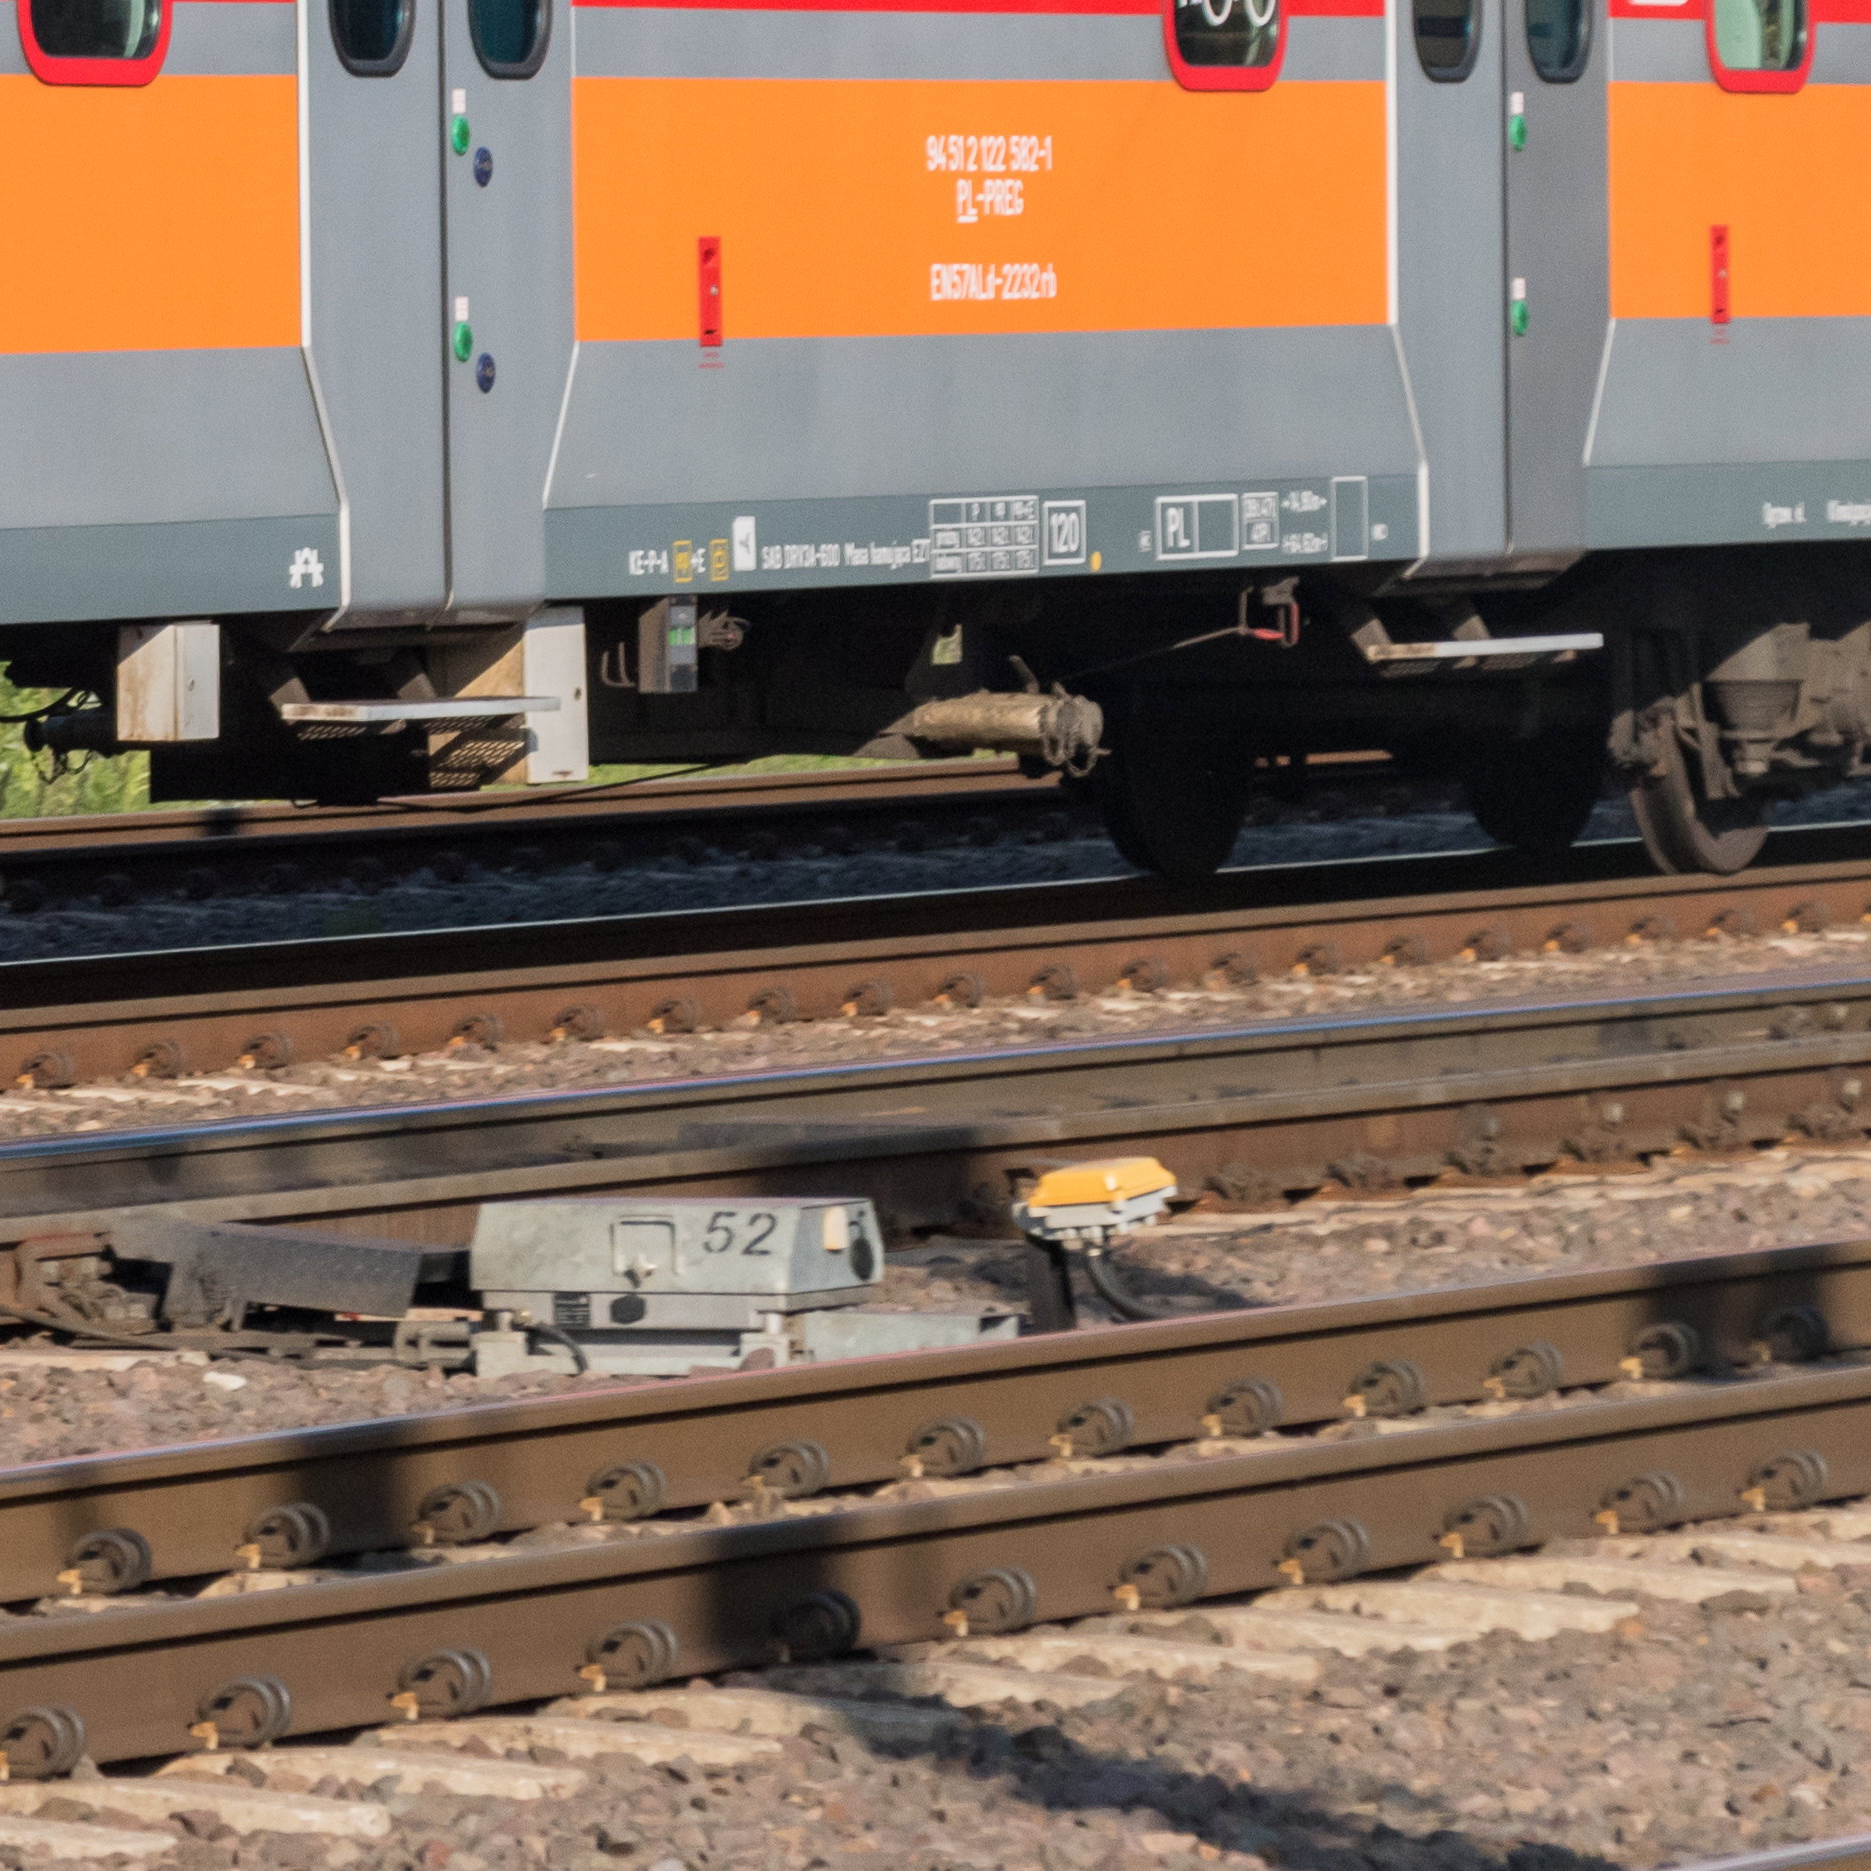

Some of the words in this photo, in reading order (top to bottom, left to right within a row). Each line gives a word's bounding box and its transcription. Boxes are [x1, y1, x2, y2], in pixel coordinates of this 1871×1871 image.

[926, 134, 947, 171] 94
[966, 135, 978, 171] 2
[980, 135, 1006, 171] 122
[1009, 135, 1053, 171] 582-1
[956, 179, 1024, 222] PL-PREG
[1050, 512, 1080, 554] 120
[1166, 506, 1191, 549] PL
[703, 1211, 778, 1256] 52
